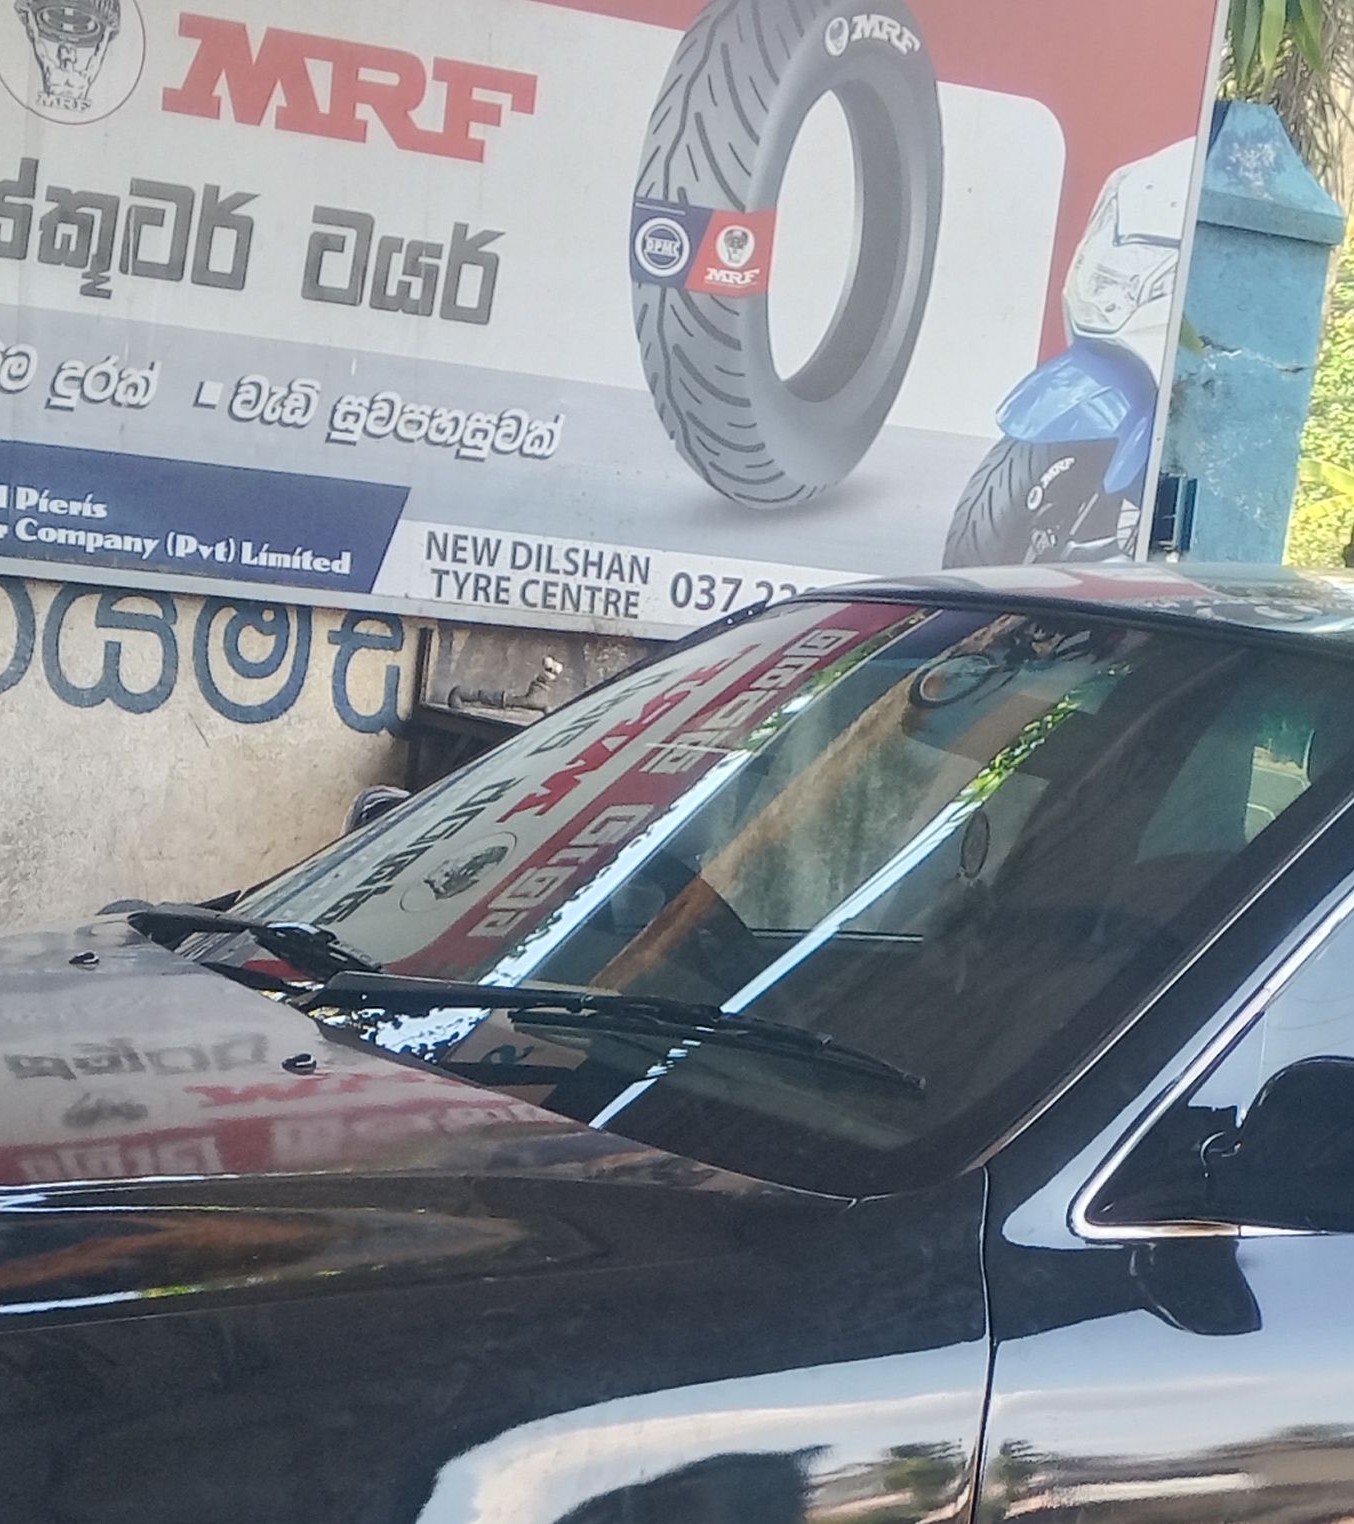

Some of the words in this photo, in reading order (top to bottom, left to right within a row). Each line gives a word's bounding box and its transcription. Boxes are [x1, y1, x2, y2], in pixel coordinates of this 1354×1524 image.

[850, 13, 921, 55] MRF
[161, 12, 538, 163] MRF
[301, 204, 506, 326] ටයර්
[704, 267, 761, 285] MRF
[228, 374, 321, 428] වැඩි
[15, 484, 108, 518] Pieris
[15, 516, 160, 560] Company
[166, 531, 236, 564] (Pvt)
[240, 541, 352, 575] Limited
[424, 530, 503, 567] NEW
[509, 539, 651, 586] DILSHAN
[430, 567, 511, 606] TYRE
[519, 577, 641, 620] CENTRE
[670, 571, 743, 613] 037
